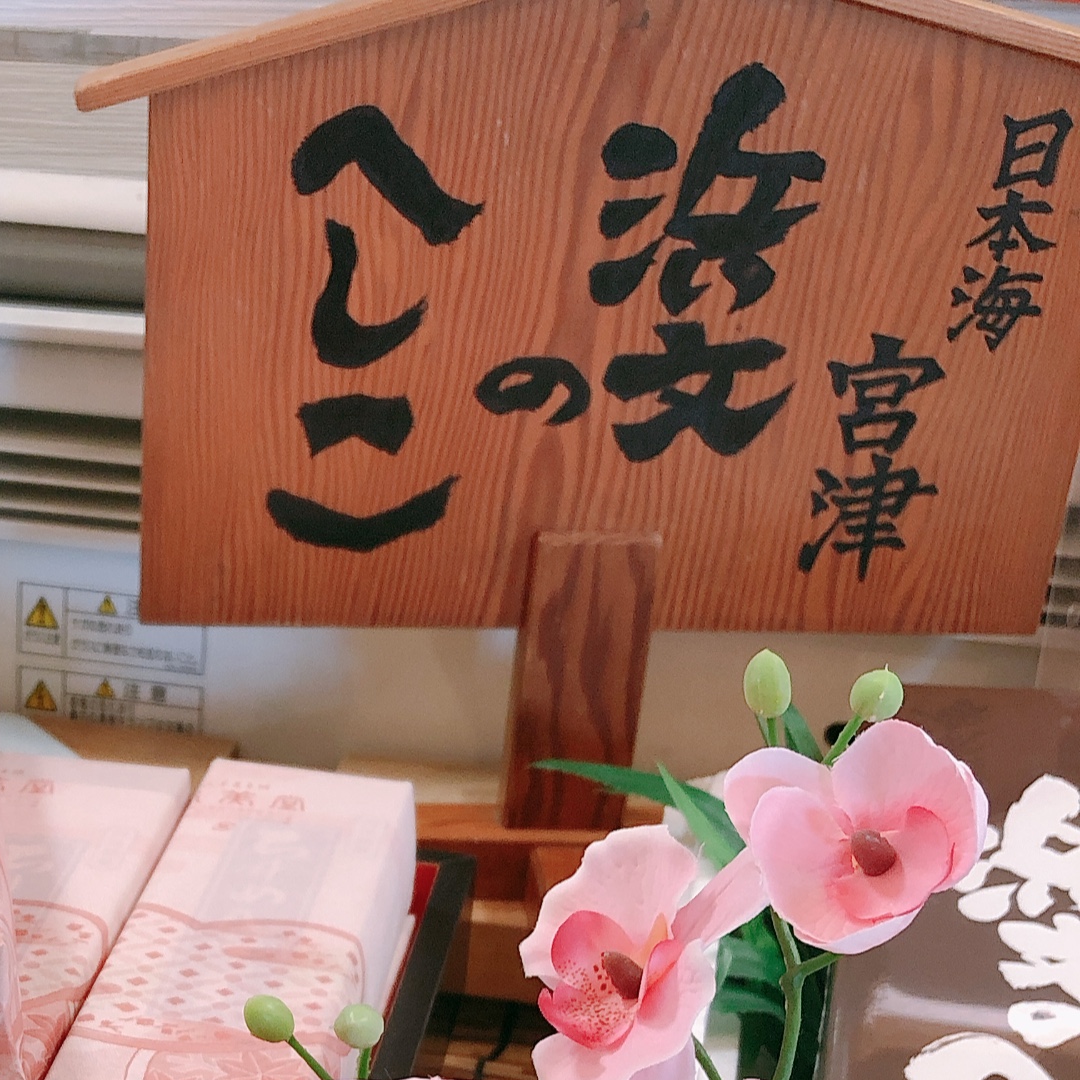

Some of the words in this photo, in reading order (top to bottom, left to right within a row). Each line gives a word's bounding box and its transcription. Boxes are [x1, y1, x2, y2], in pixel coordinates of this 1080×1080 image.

[266, 104, 484, 554] へしこ
[946, 108, 1074, 351] 日本海
[797, 332, 947, 582] 宮津
